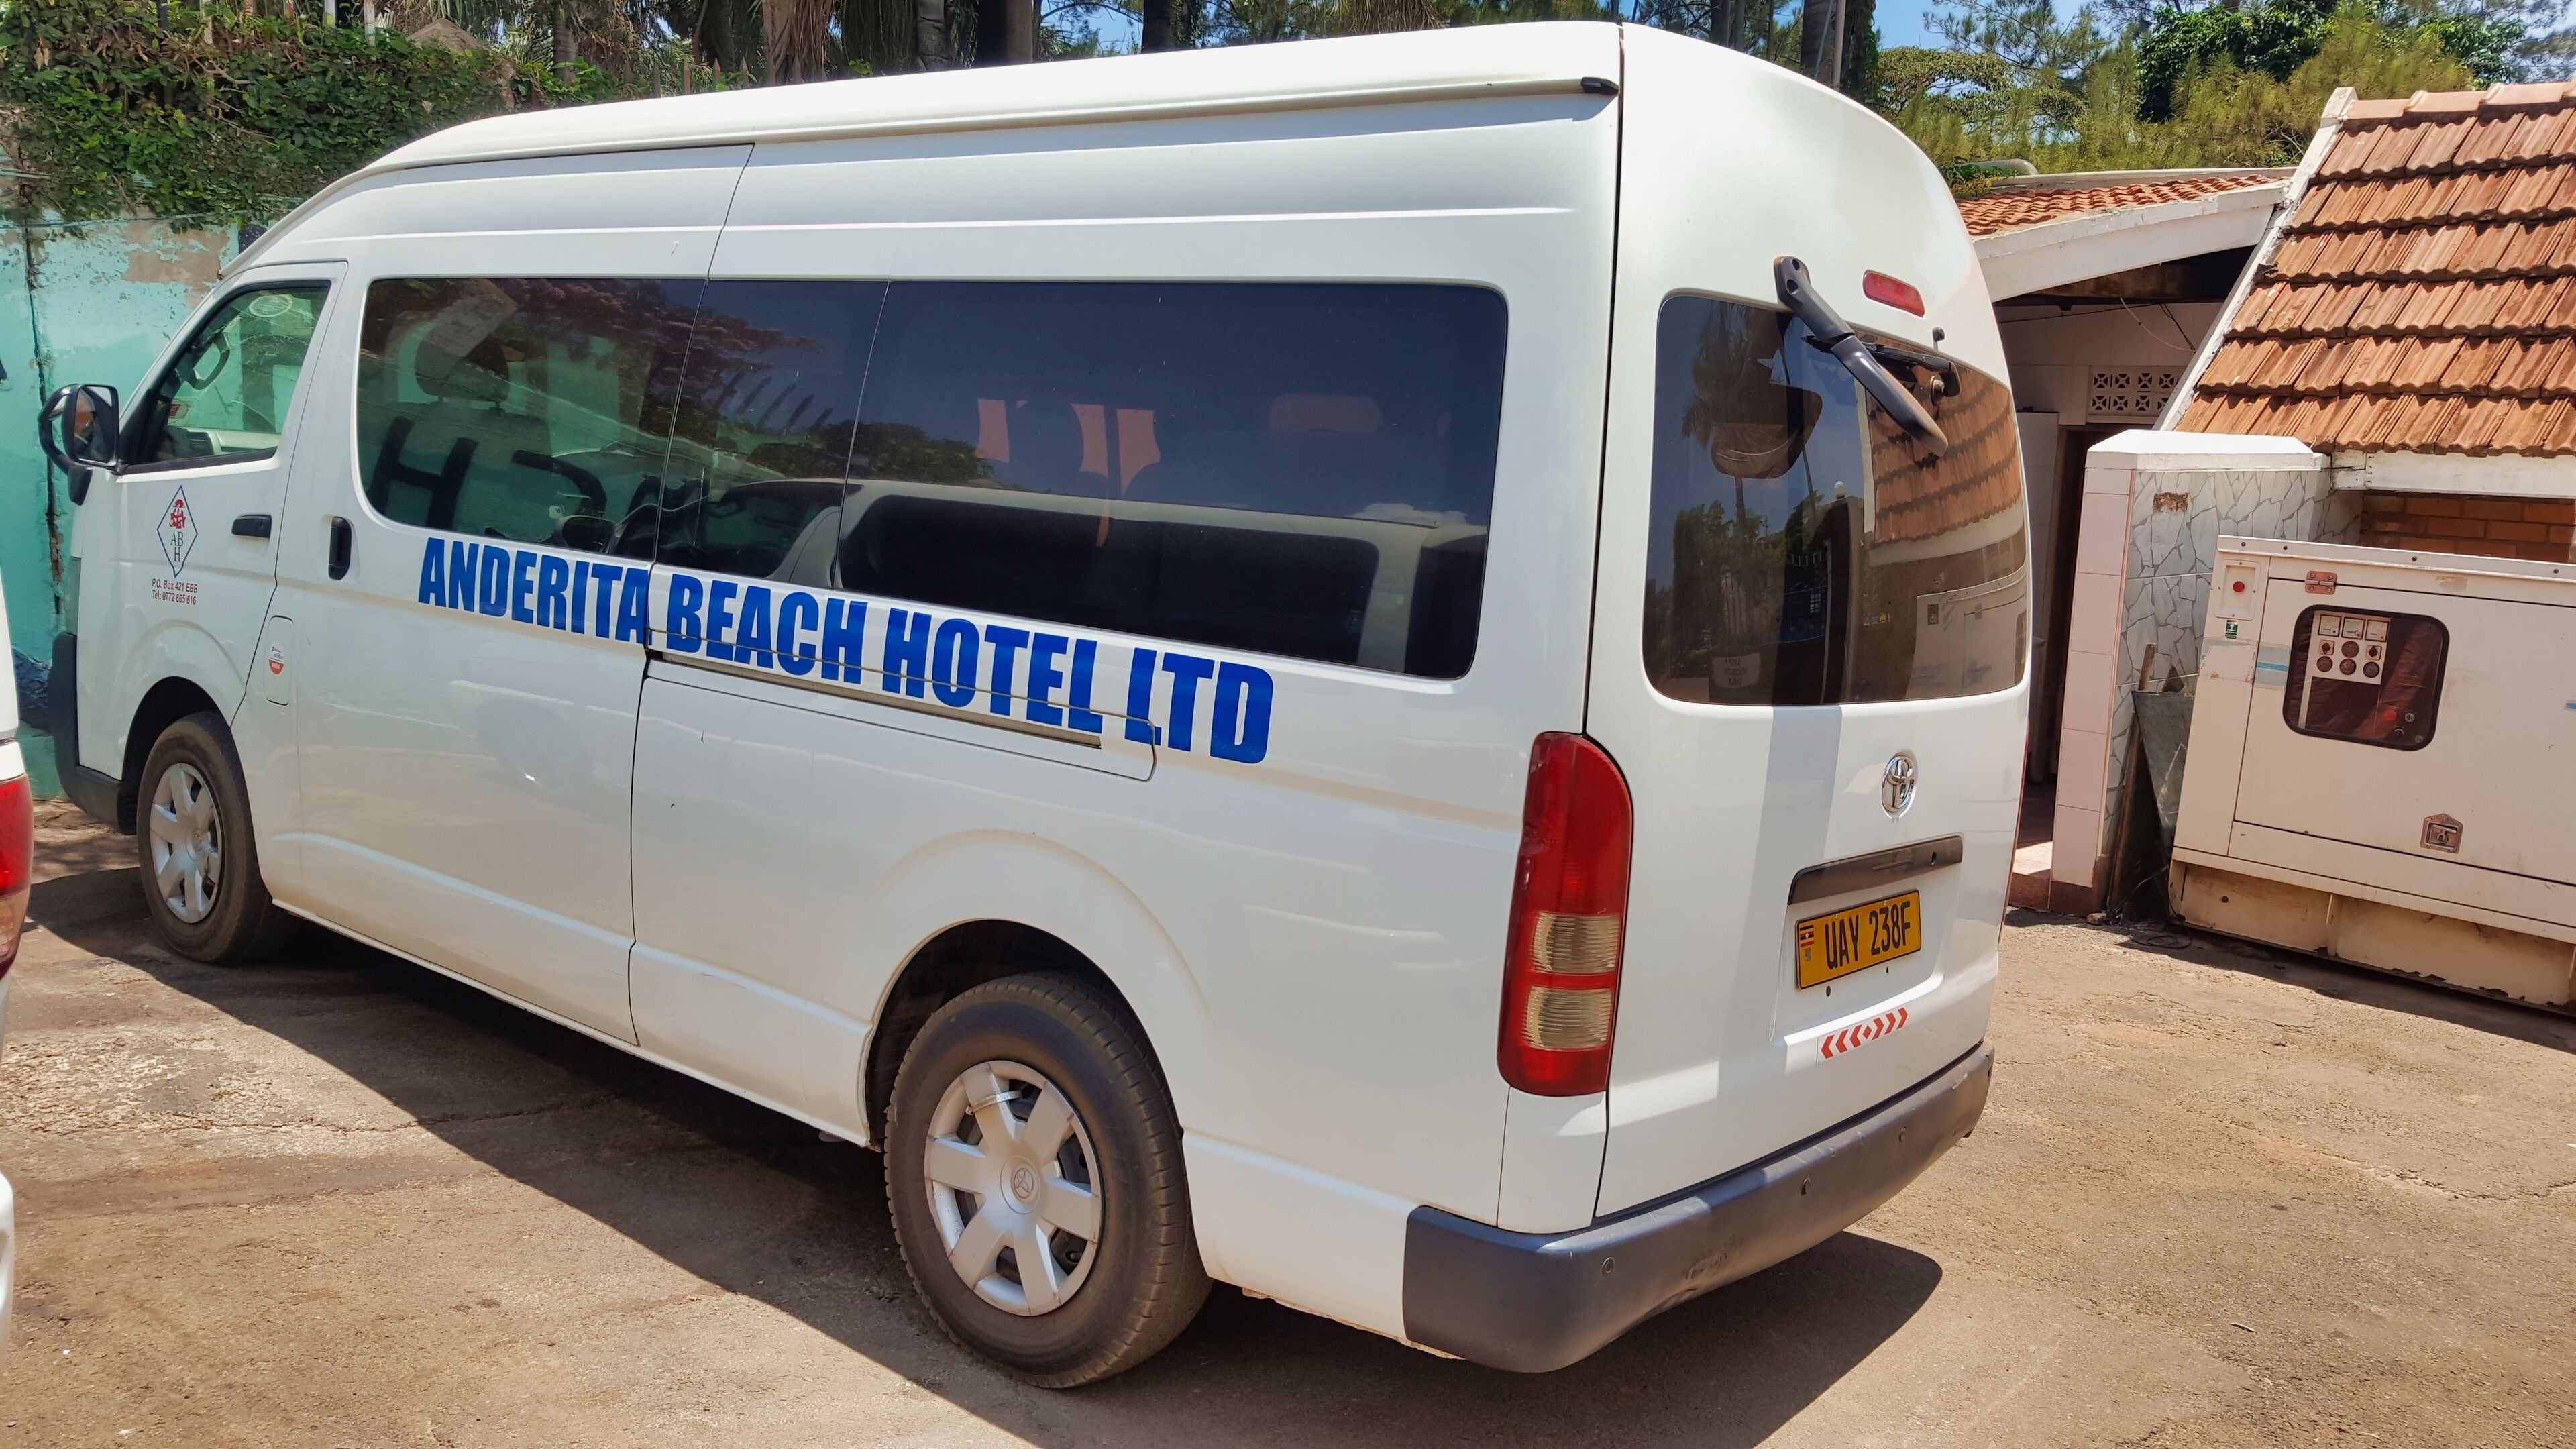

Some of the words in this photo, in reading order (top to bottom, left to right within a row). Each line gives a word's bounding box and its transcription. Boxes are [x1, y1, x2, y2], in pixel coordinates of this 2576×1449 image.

[170, 531, 184, 547] AB
[174, 547, 180, 562] H
[152, 578, 162, 588] P.O.
[163, 580, 174, 590] Box
[175, 582, 184, 592] 421
[186, 583, 198, 593] EBB
[152, 590, 161, 600] Tel:
[162, 592, 175, 602] 0772
[176, 594, 185, 603] 665
[186, 595, 197, 605] 616
[419, 537, 653, 645] ANDERITA
[667, 573, 868, 684] BEACH
[882, 607, 1104, 734] HOTEL
[1124, 647, 1274, 764] LTD
[1825, 914, 1859, 970] UAY
[1869, 900, 1911, 956] 238F
